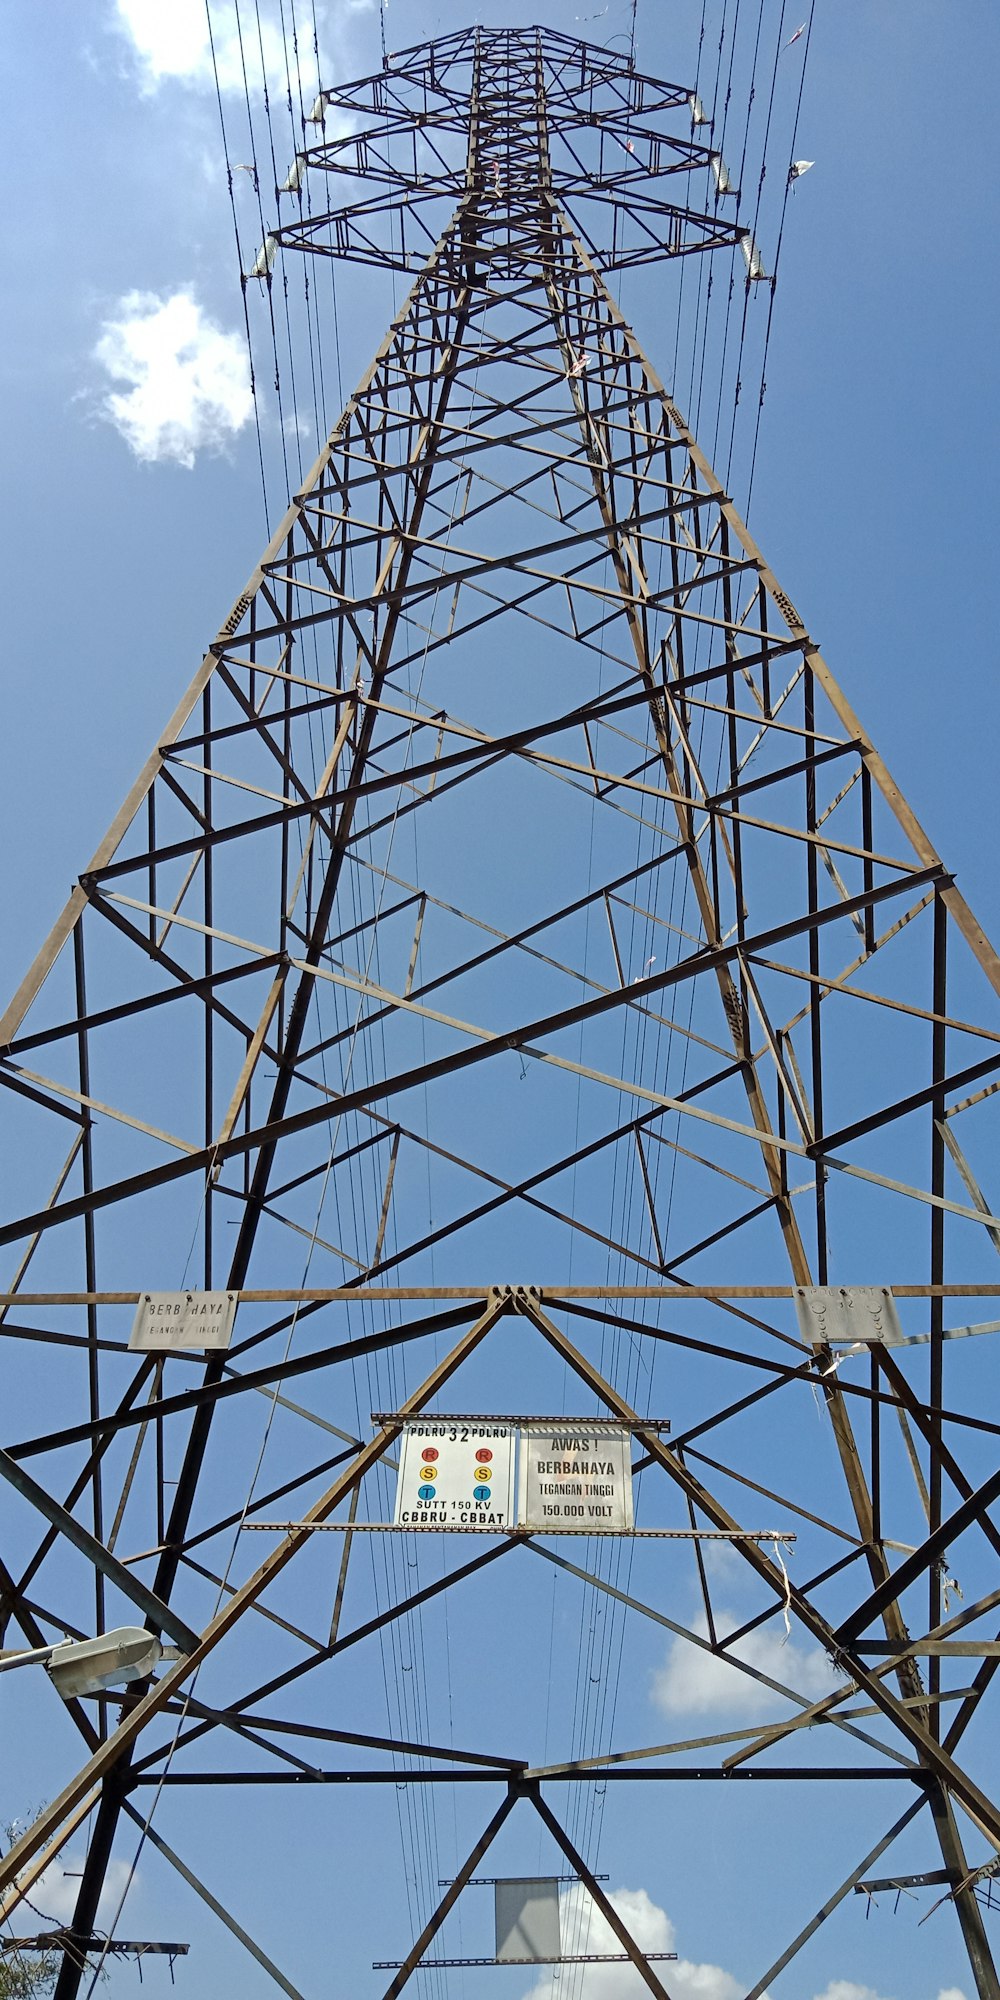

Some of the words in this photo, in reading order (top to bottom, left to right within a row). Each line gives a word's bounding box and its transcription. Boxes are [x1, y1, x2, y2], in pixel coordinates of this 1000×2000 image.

[411, 1428, 446, 1437] PDLRU
[449, 1427, 469, 1442] 32
[472, 1428, 507, 1438] PDLRU
[551, 1438, 590, 1451] AWAS
[537, 1461, 615, 1475] BERBAHAYA
[539, 1483, 582, 1495] TEGANGAN
[585, 1484, 614, 1497] TINGGI
[416, 1500, 447, 1509] SUTT
[451, 1501, 471, 1510] 150
[475, 1501, 492, 1510] KV
[542, 1504, 585, 1516] 150.000
[588, 1505, 613, 1517] VOLT
[402, 1511, 447, 1522] CBBRU
[460, 1512, 504, 1524] CBBAT
